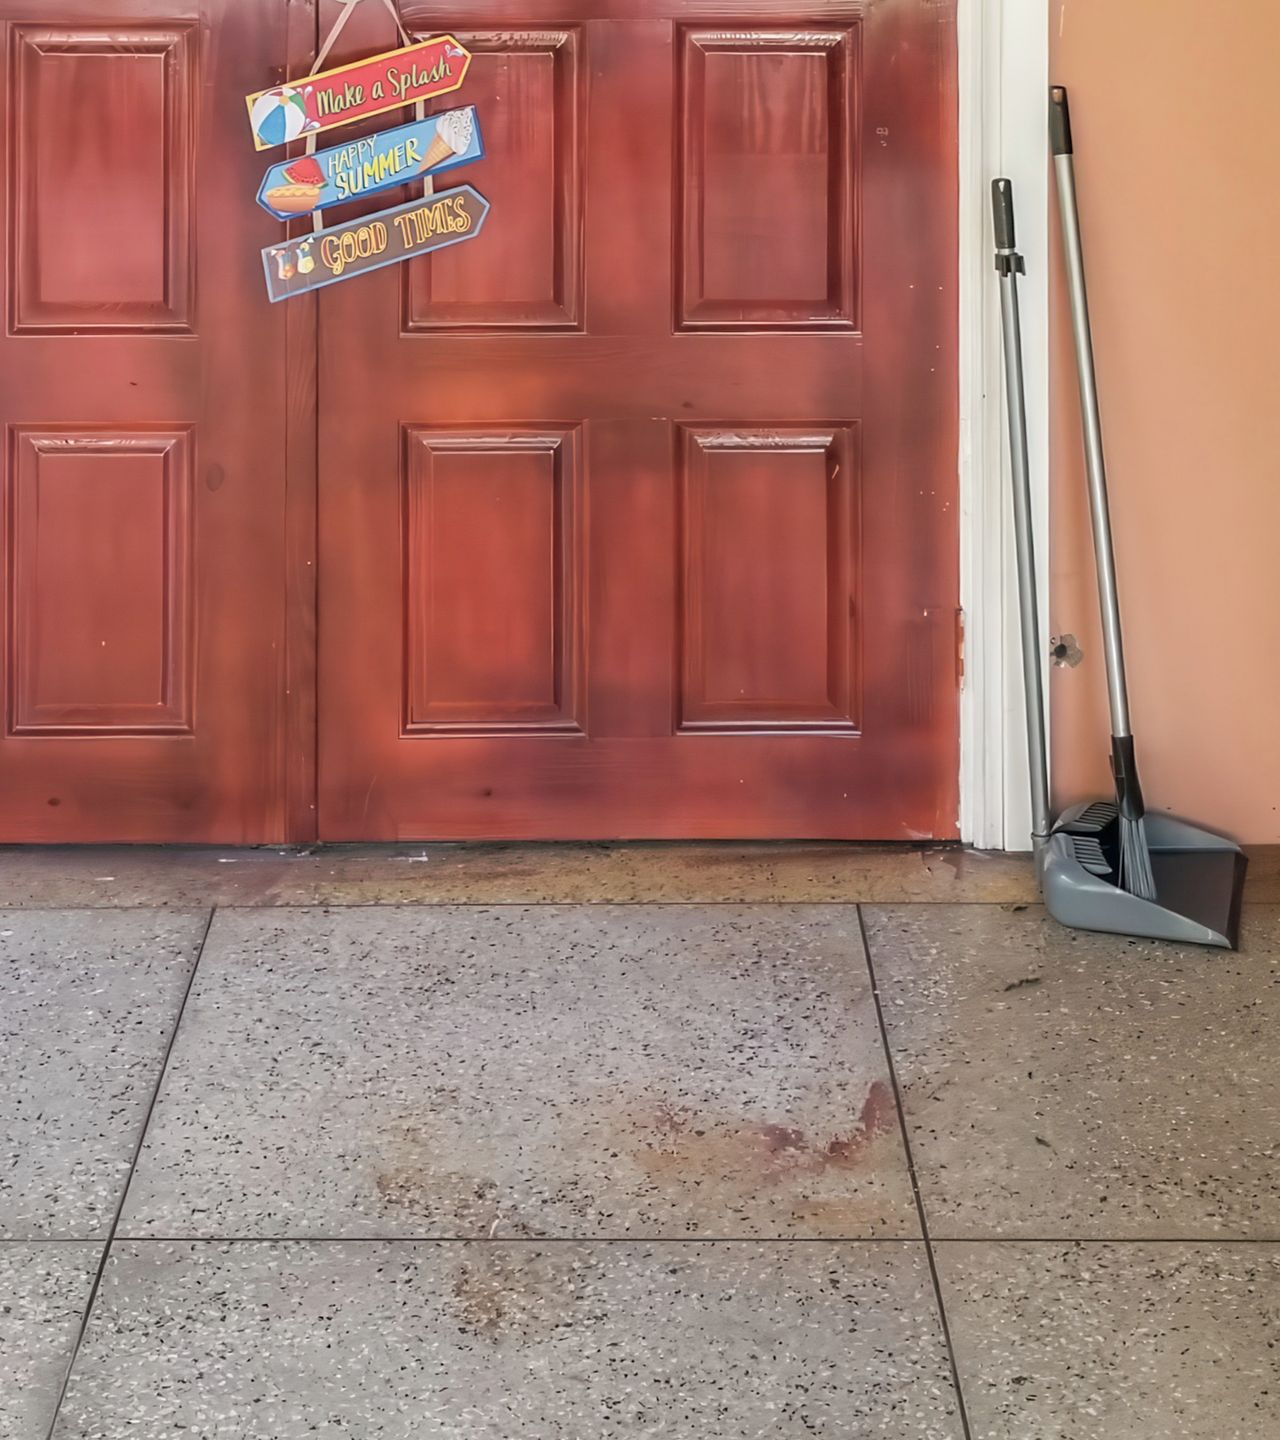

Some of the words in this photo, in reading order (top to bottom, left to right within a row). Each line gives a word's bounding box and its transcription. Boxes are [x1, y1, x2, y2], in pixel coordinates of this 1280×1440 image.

[316, 85, 366, 117] Make
[372, 82, 383, 99] a
[386, 55, 452, 100] Splash
[328, 135, 377, 175] HAPPY
[335, 138, 422, 199] SUMMER
[321, 224, 389, 274] GOOD
[394, 196, 471, 248] TIMES
